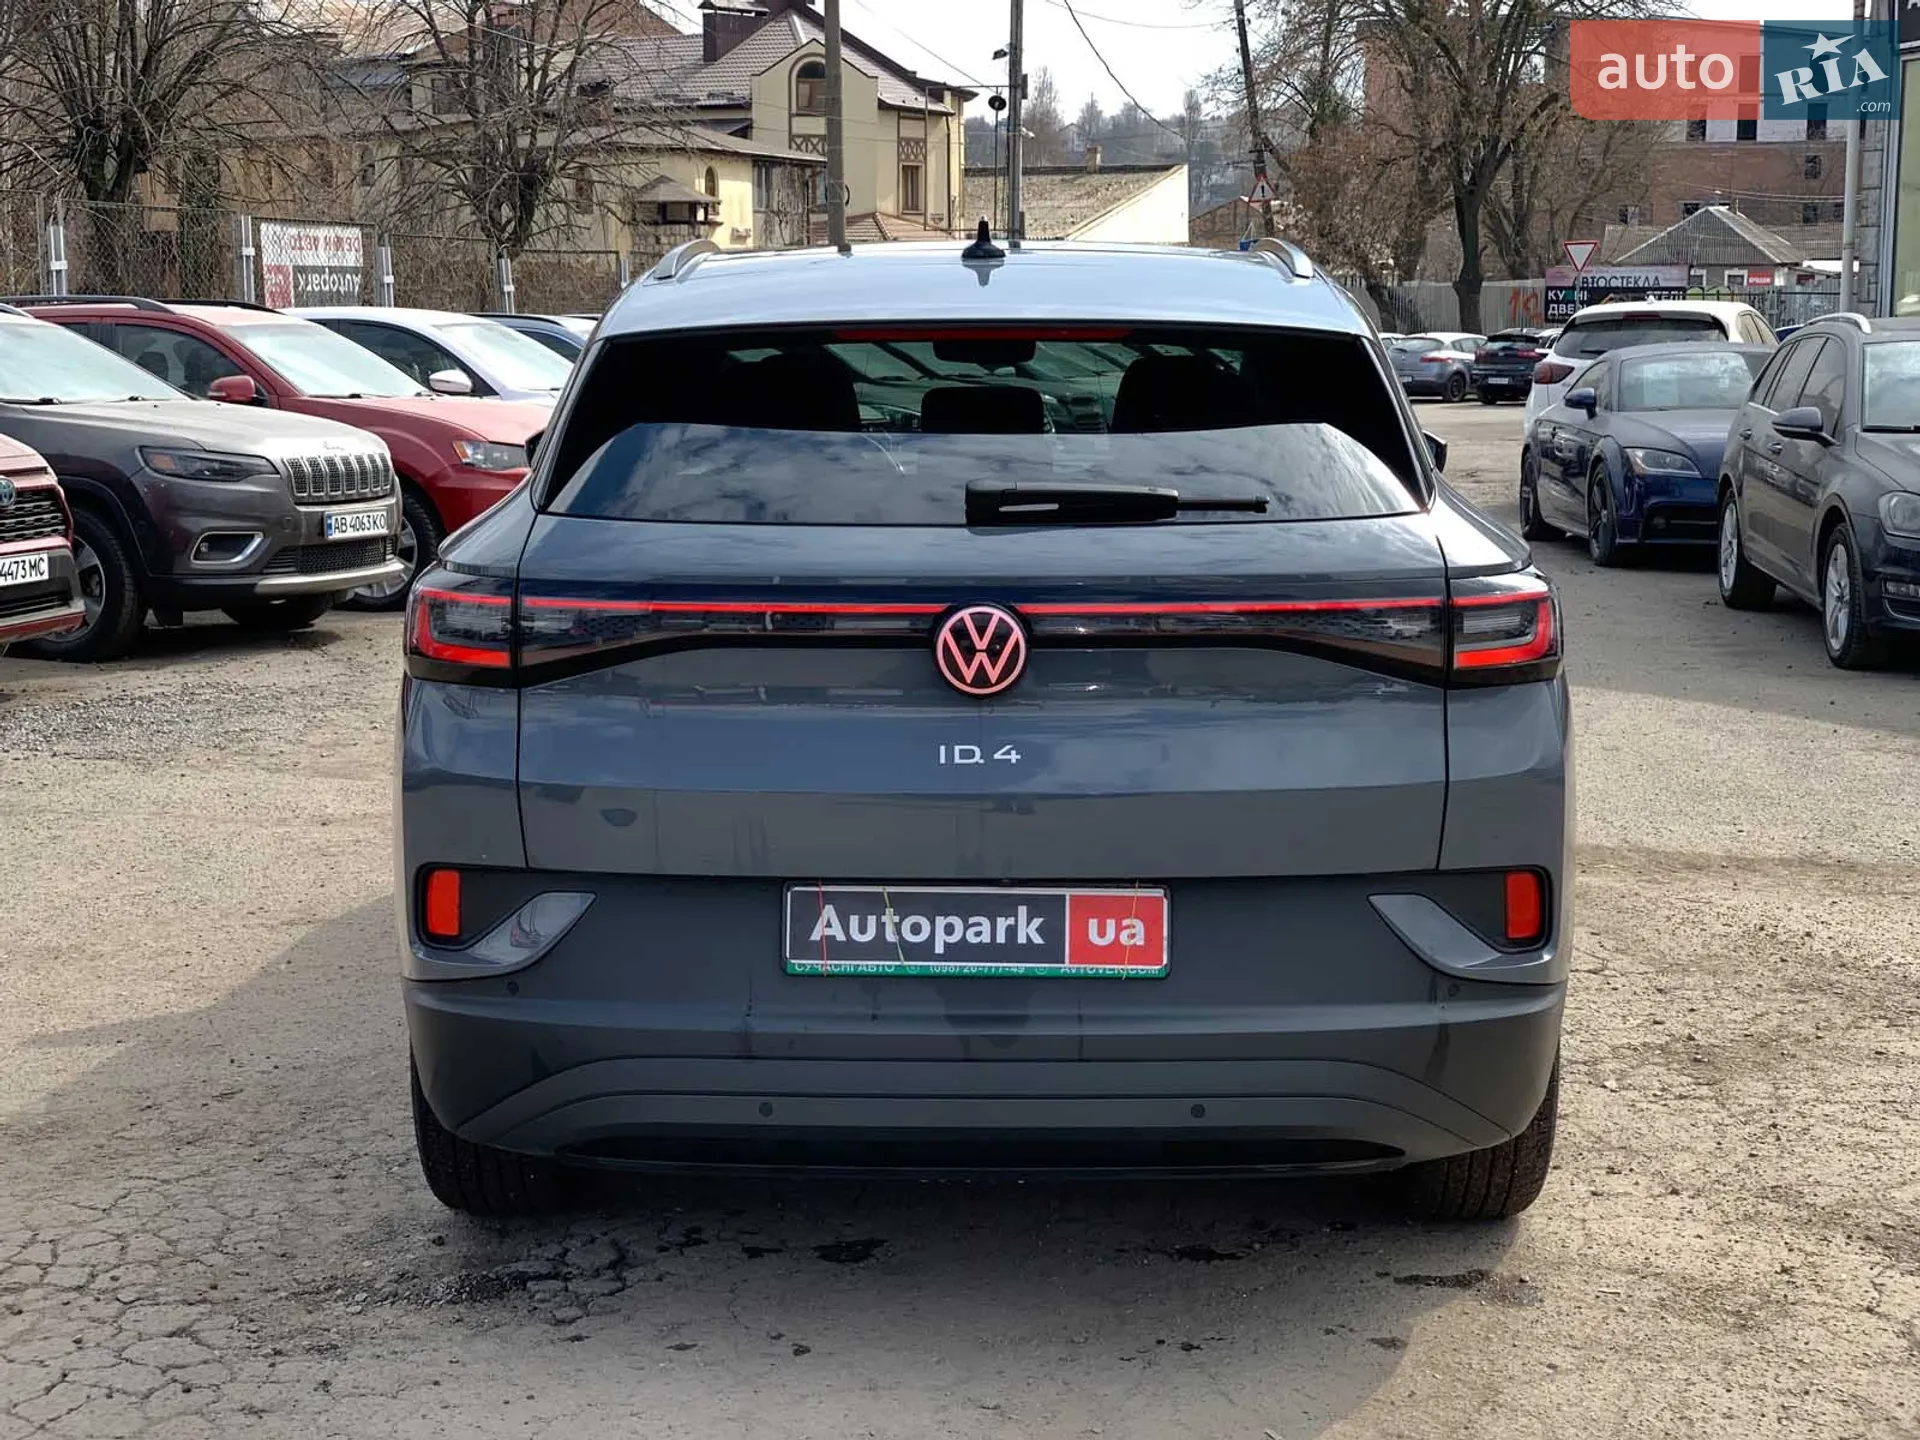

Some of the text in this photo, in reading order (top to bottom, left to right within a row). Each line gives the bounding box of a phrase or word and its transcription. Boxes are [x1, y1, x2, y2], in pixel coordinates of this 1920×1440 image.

[297, 267, 361, 298] Autopark
[1547, 289, 1588, 301] КУНІ
[333, 513, 387, 534] AB 4063 KO
[28, 557, 45, 577] MC
[809, 904, 1146, 954] Autopark ua
